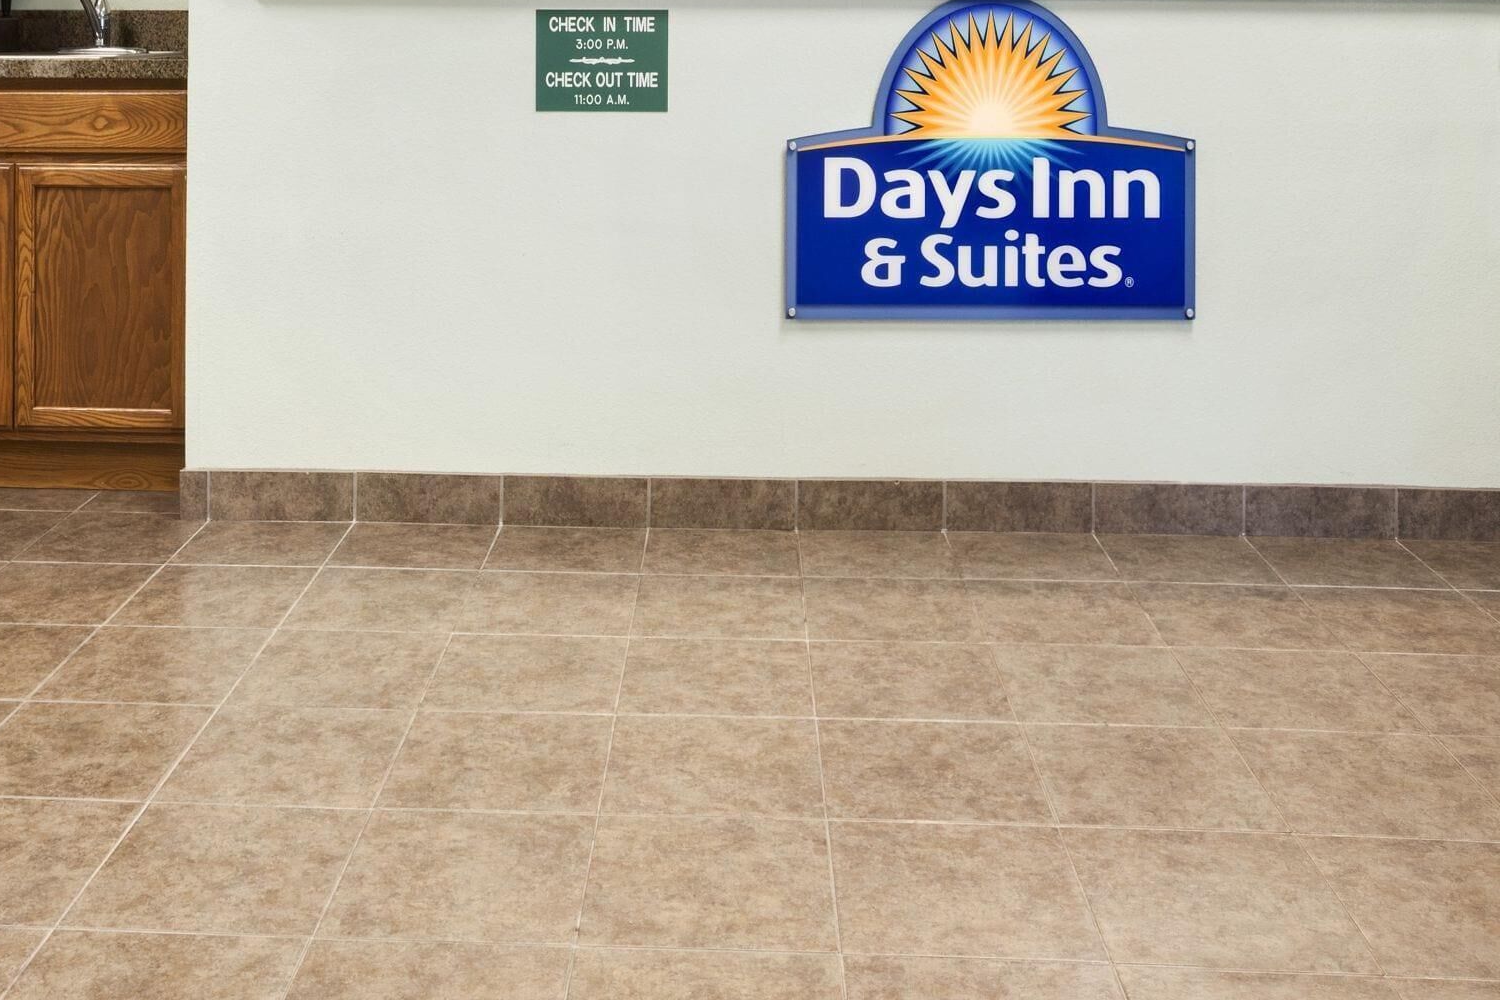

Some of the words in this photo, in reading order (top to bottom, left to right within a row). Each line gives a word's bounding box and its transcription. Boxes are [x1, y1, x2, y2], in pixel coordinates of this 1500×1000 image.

[548, 16, 595, 33] CHECK
[603, 16, 616, 33] IN
[624, 16, 656, 33] TIME
[575, 38, 602, 50] 3:00
[606, 38, 629, 50] P.M.
[545, 71, 592, 88] CHECK
[595, 71, 623, 88] OUT
[627, 71, 659, 88] TIME
[574, 94, 602, 105] 11:00
[606, 94, 630, 105] A.M.
[823, 157, 1016, 229] Days
[1033, 157, 1161, 218] Inn
[861, 237, 906, 287] &
